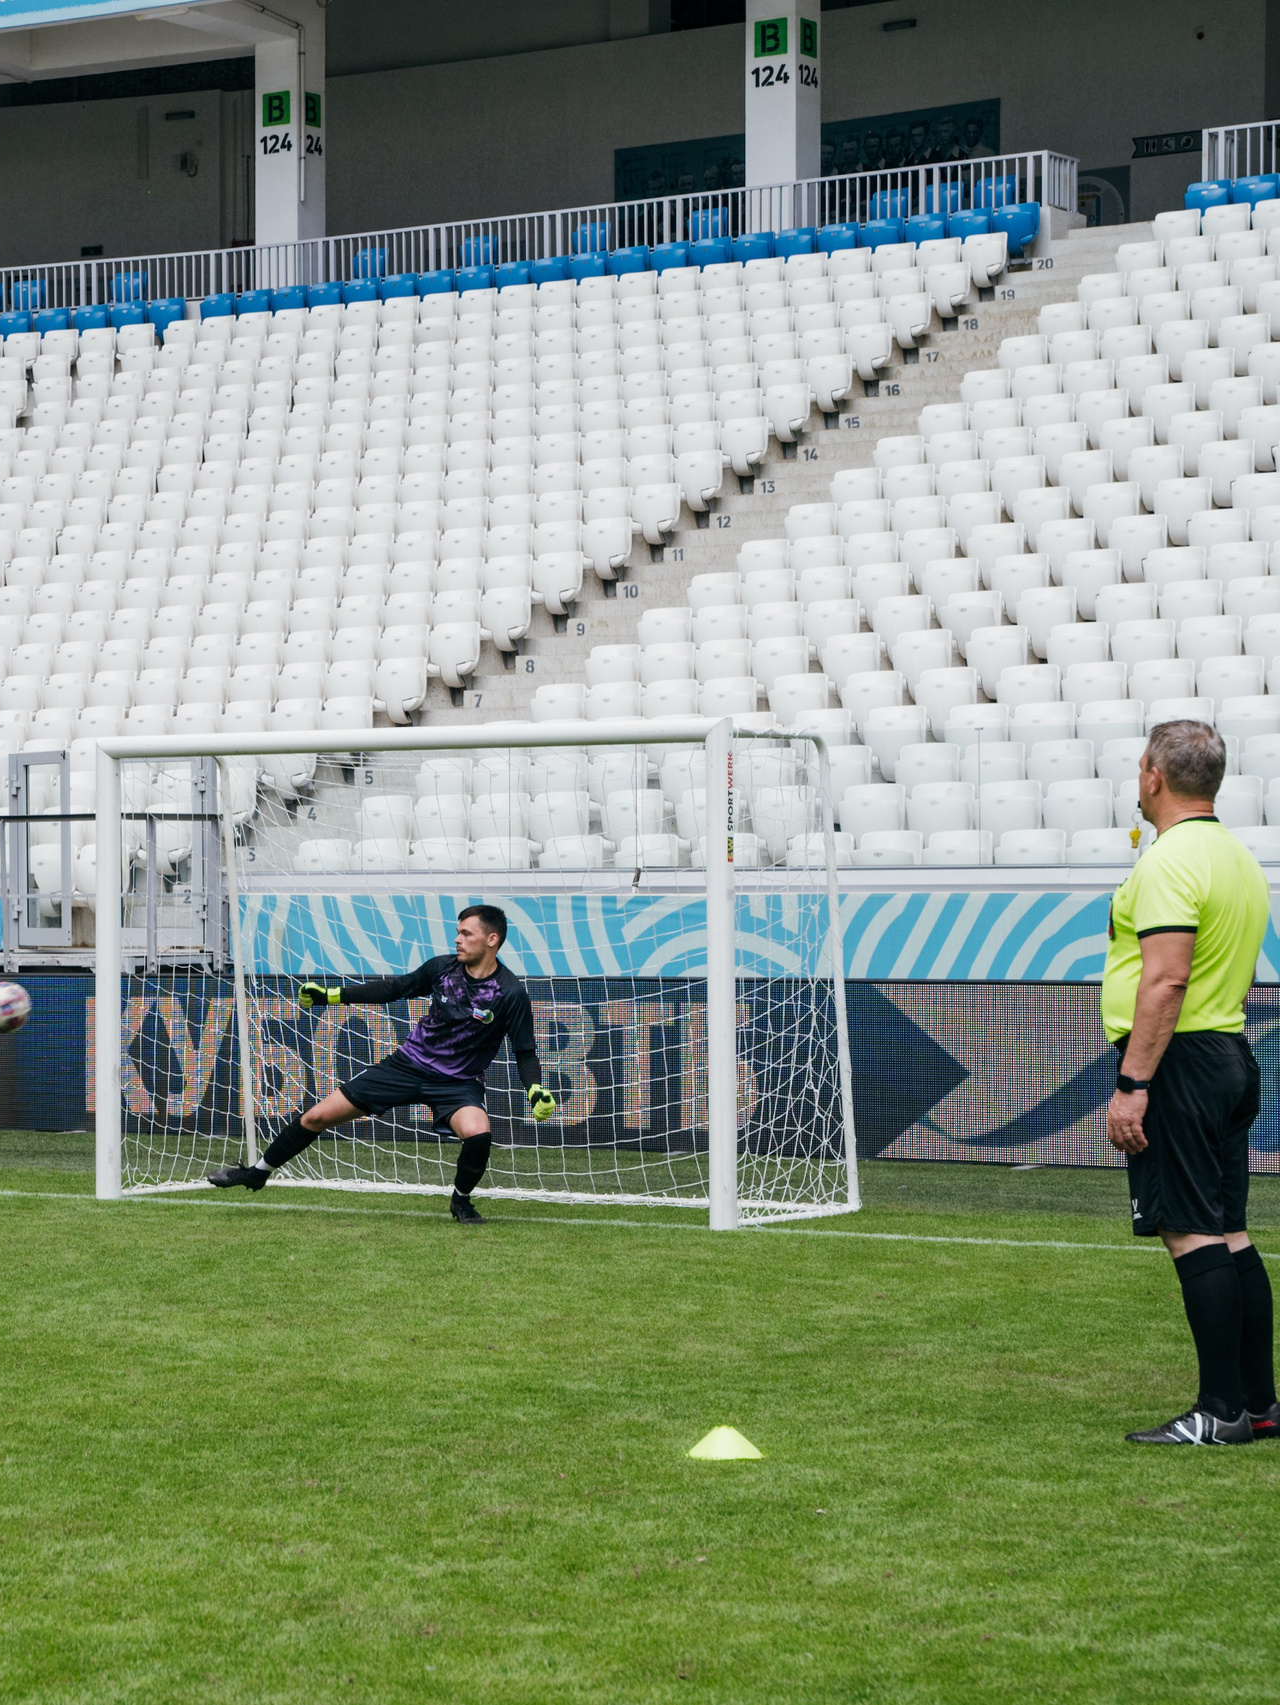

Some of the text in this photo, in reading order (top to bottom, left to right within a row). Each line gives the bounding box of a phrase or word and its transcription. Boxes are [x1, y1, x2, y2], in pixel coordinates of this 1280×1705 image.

[761, 23, 780, 53] B
[803, 22, 813, 52] B
[751, 63, 790, 88] 124
[798, 63, 818, 89] 124
[268, 95, 284, 122] B
[305, 95, 316, 123] B
[260, 132, 292, 155] 124
[306, 134, 323, 156] 24
[1037, 258, 1054, 270] 20
[1001, 289, 1015, 301] 19
[963, 318, 979, 330] 18
[926, 351, 939, 362] 17
[885, 384, 900, 396] 16
[845, 416, 860, 429] 15
[803, 448, 818, 461] 14
[761, 481, 775, 494] 13
[716, 515, 731, 528] 12
[672, 548, 684, 562] 11
[623, 584, 638, 598] 10
[576, 622, 585, 636] 9
[525, 659, 535, 673] 8
[474, 693, 483, 708] 7
[365, 770, 373, 785] 5
[307, 806, 317, 821] 4
[183, 889, 192, 904] 2
[85, 996, 434, 1123] КУБО
